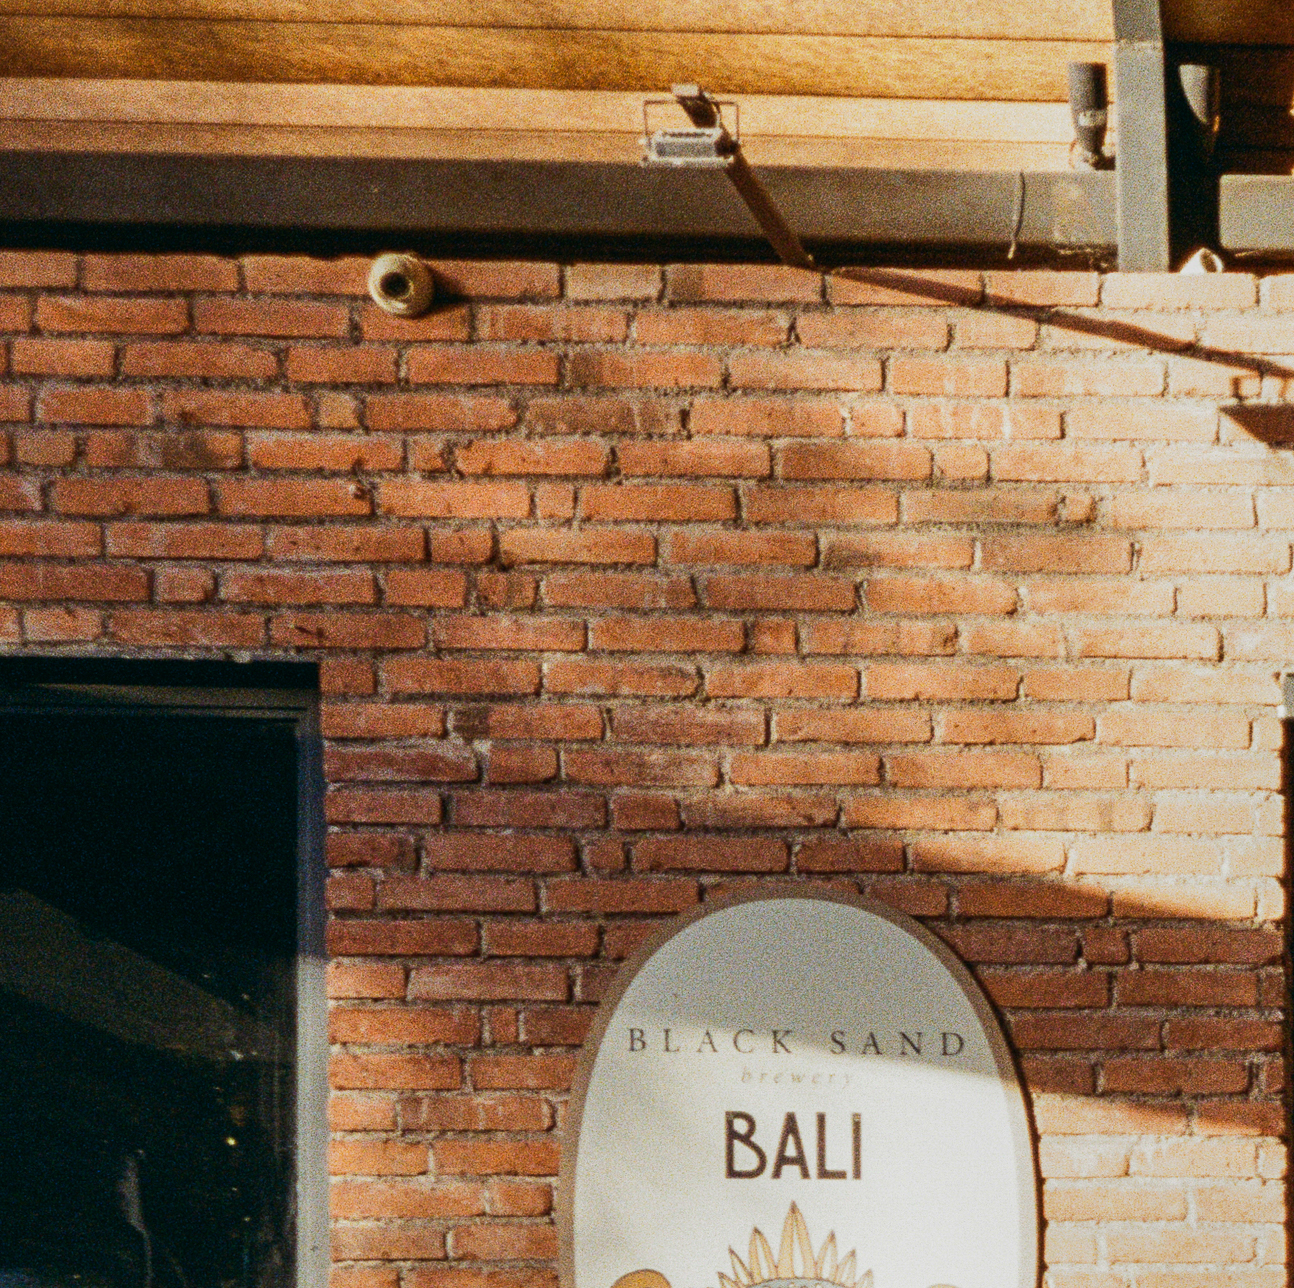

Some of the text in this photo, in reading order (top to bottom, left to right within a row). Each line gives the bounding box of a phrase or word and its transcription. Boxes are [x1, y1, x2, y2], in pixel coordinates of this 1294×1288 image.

[627, 1028, 965, 1056] BLACK SAND
[741, 1066, 857, 1088] brewery
[724, 1110, 862, 1180] BALI
